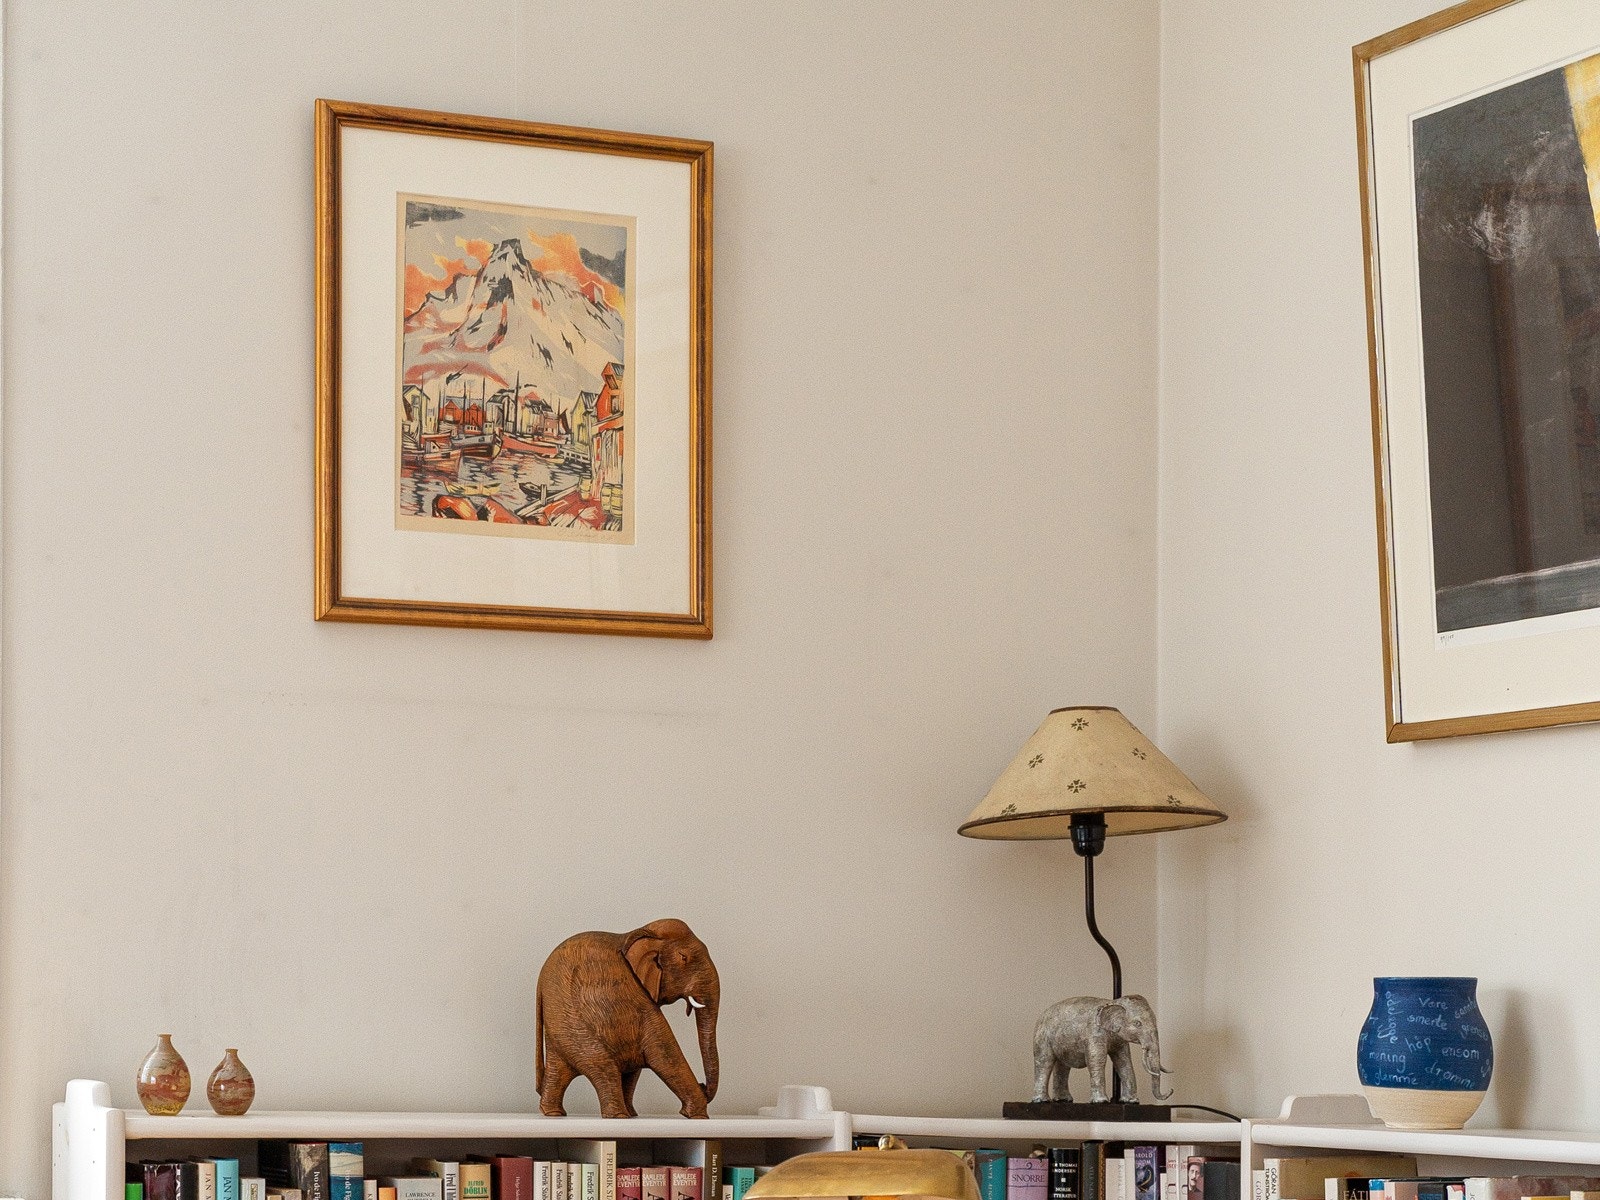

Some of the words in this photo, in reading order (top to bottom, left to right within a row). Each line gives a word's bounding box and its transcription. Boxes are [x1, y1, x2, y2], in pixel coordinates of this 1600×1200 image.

[313, 1171, 321, 1182] Ivo
[1011, 1174, 1046, 1183] SNORRE
[222, 1177, 232, 1193] JAN
[313, 1183, 321, 1191] de
[586, 1171, 594, 1195] Fredrik
